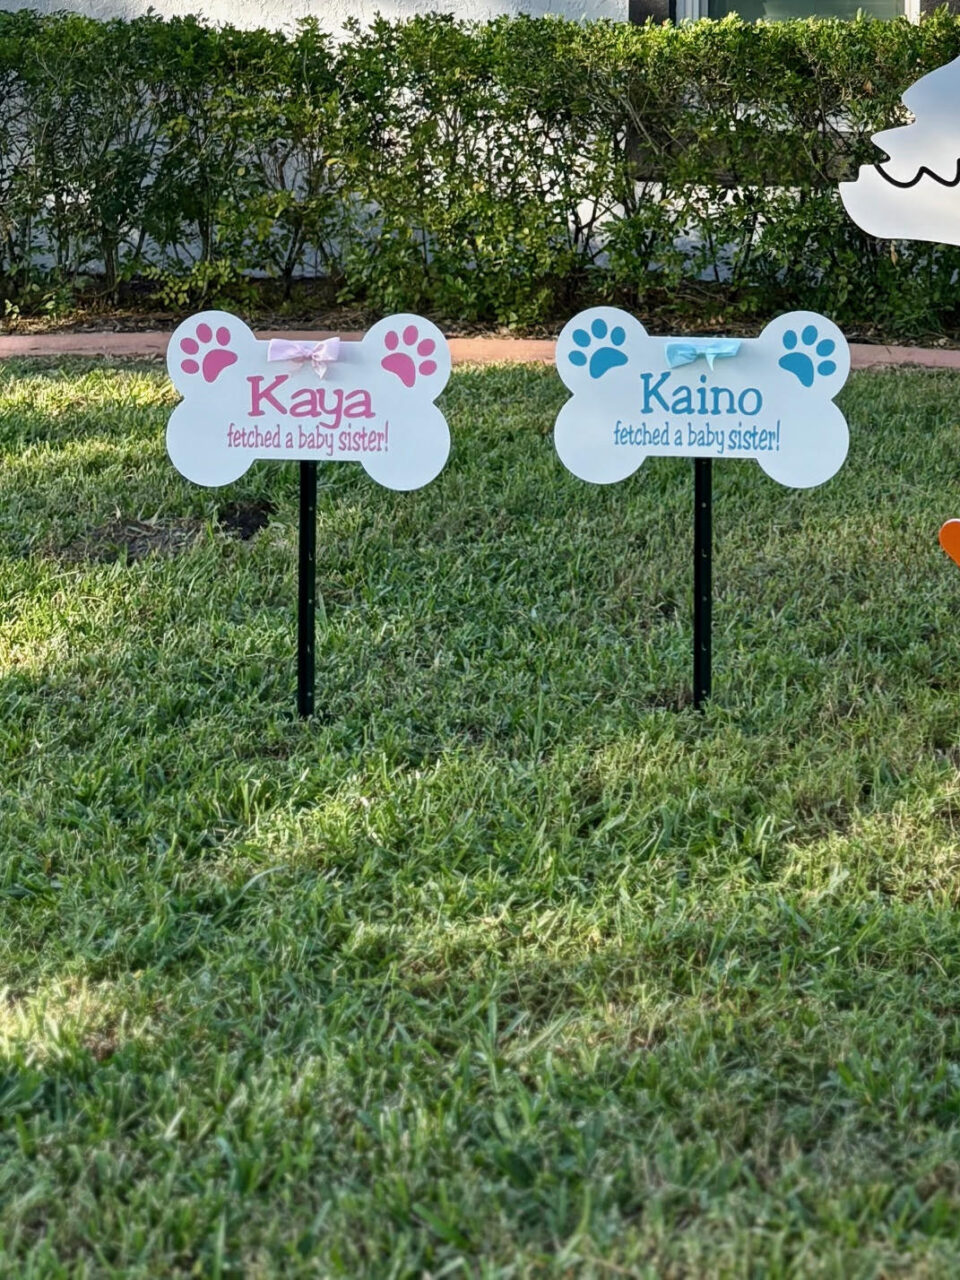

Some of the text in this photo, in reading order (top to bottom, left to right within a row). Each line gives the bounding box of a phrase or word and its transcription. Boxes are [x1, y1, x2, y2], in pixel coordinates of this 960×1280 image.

[246, 374, 376, 430] Kaya
[640, 371, 763, 415] Kaino
[227, 420, 389, 456] fetched a baby sister!
[613, 419, 781, 454] fetched a baby sister!
